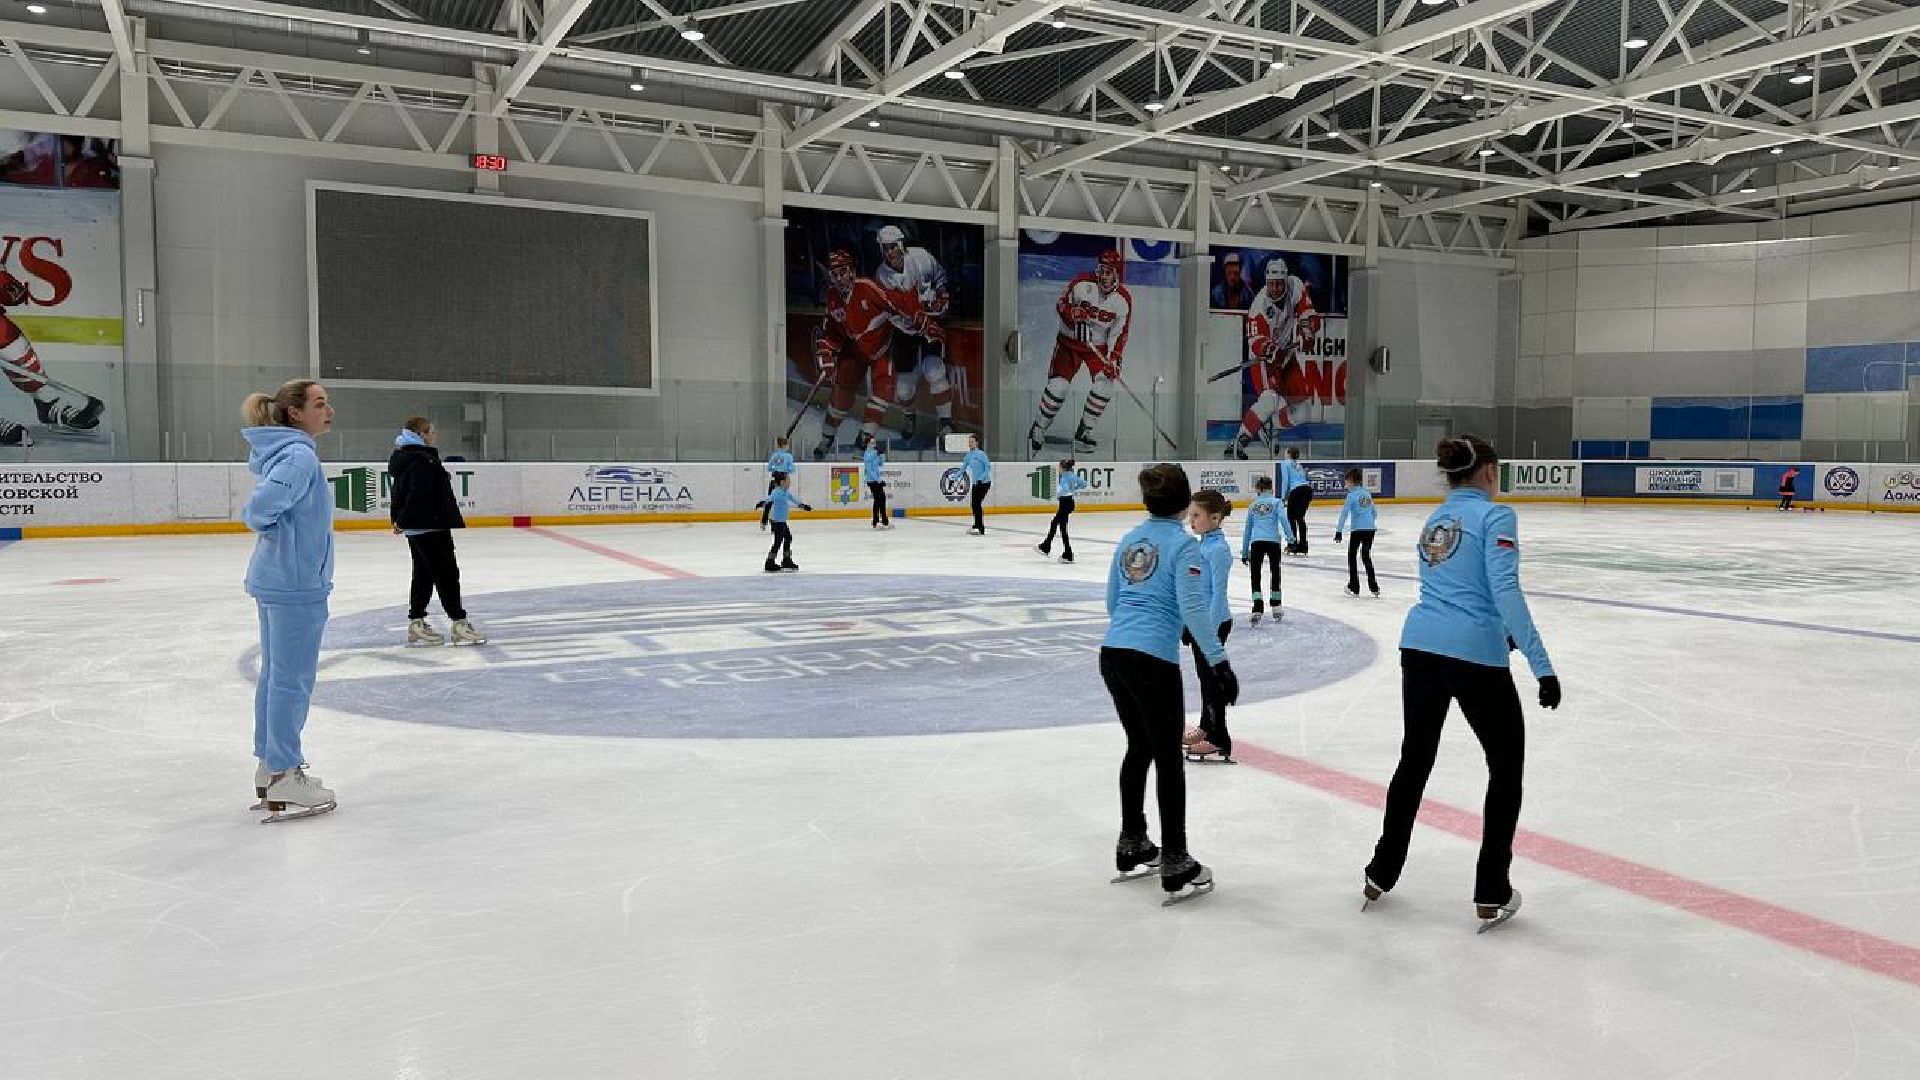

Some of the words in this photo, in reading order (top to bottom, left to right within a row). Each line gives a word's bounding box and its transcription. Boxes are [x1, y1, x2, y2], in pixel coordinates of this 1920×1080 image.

[1515, 465, 1577, 484] МОСТ
[0, 485, 79, 499] ОВСКОЙ
[569, 486, 693, 502] ЛЕГЕНДА
